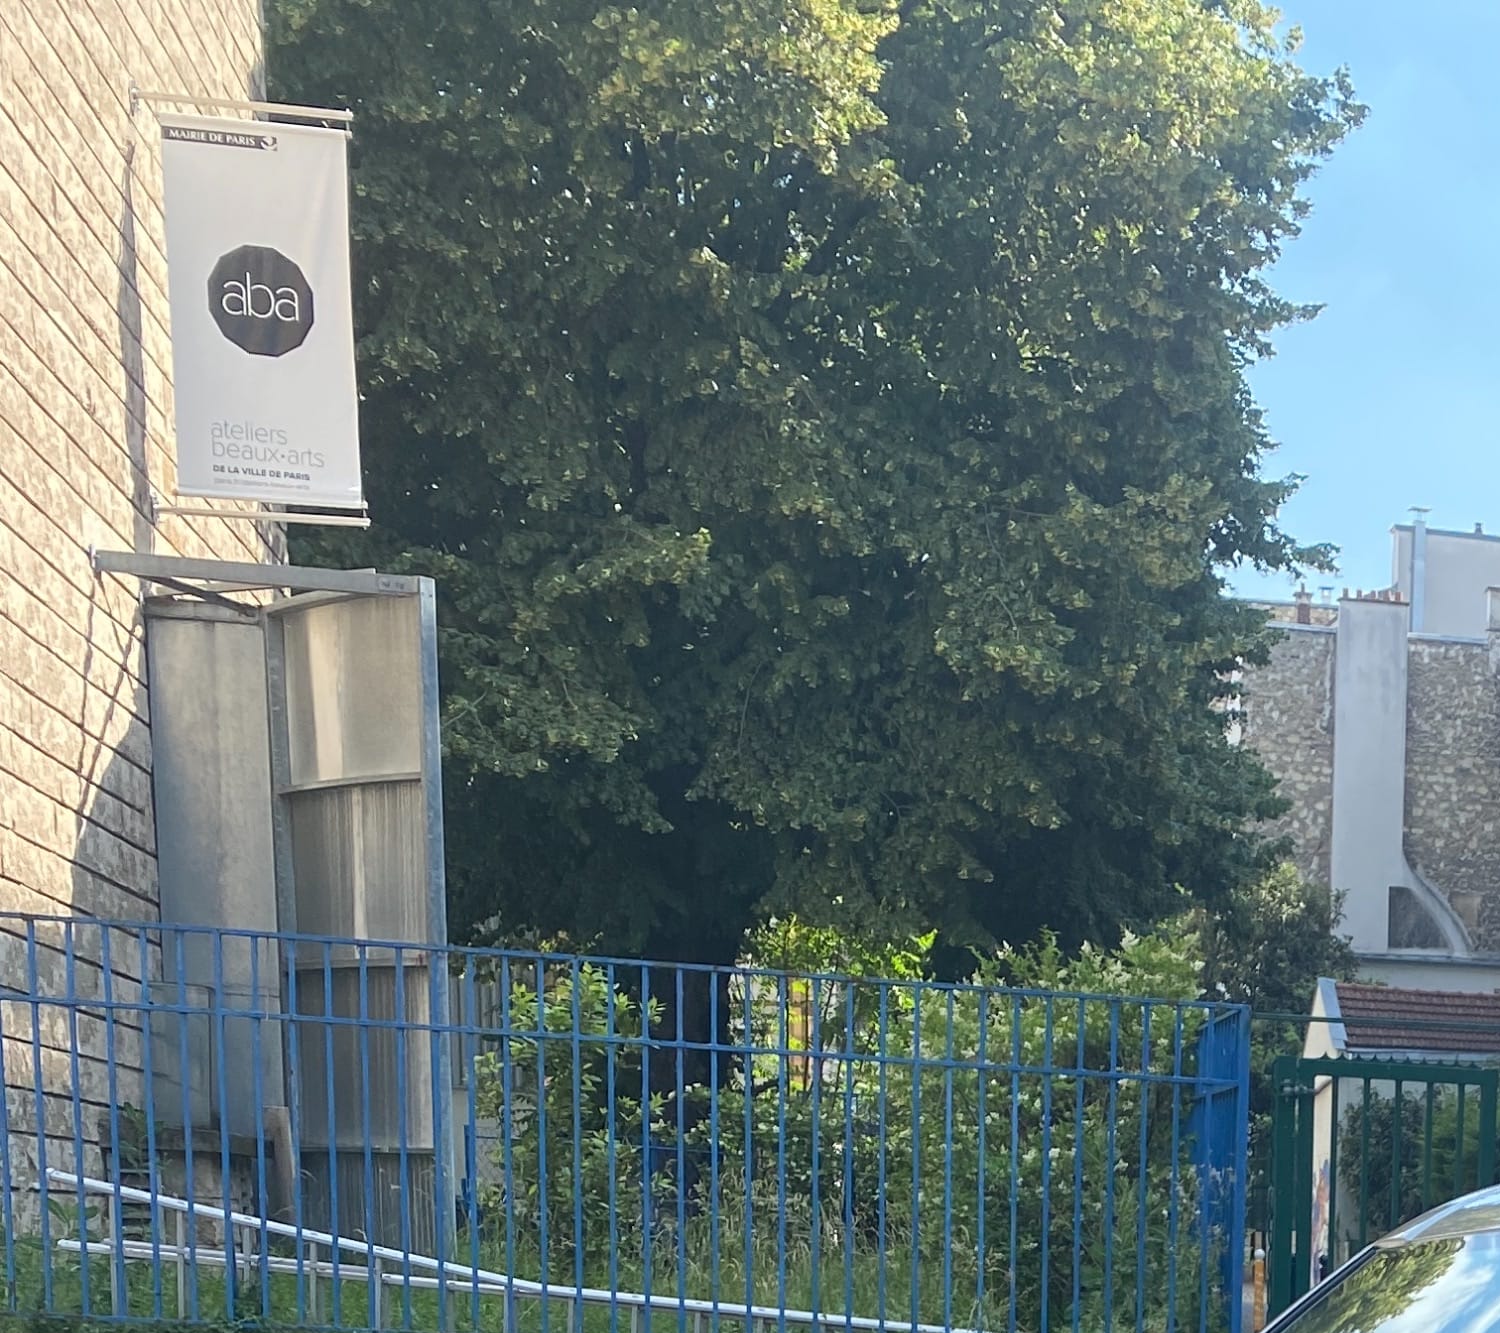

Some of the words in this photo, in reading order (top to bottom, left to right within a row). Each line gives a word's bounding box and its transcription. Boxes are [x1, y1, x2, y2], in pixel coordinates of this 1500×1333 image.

[169, 128, 206, 141] MAIRIE
[208, 132, 225, 143] DE
[226, 135, 256, 146] PARIS
[222, 271, 299, 321] aba
[211, 419, 288, 445] ateliers
[212, 464, 225, 473] DE
[227, 466, 240, 474] LA
[242, 467, 267, 477] VILLE
[269, 470, 281, 478] DE
[283, 471, 311, 481] PARIS
